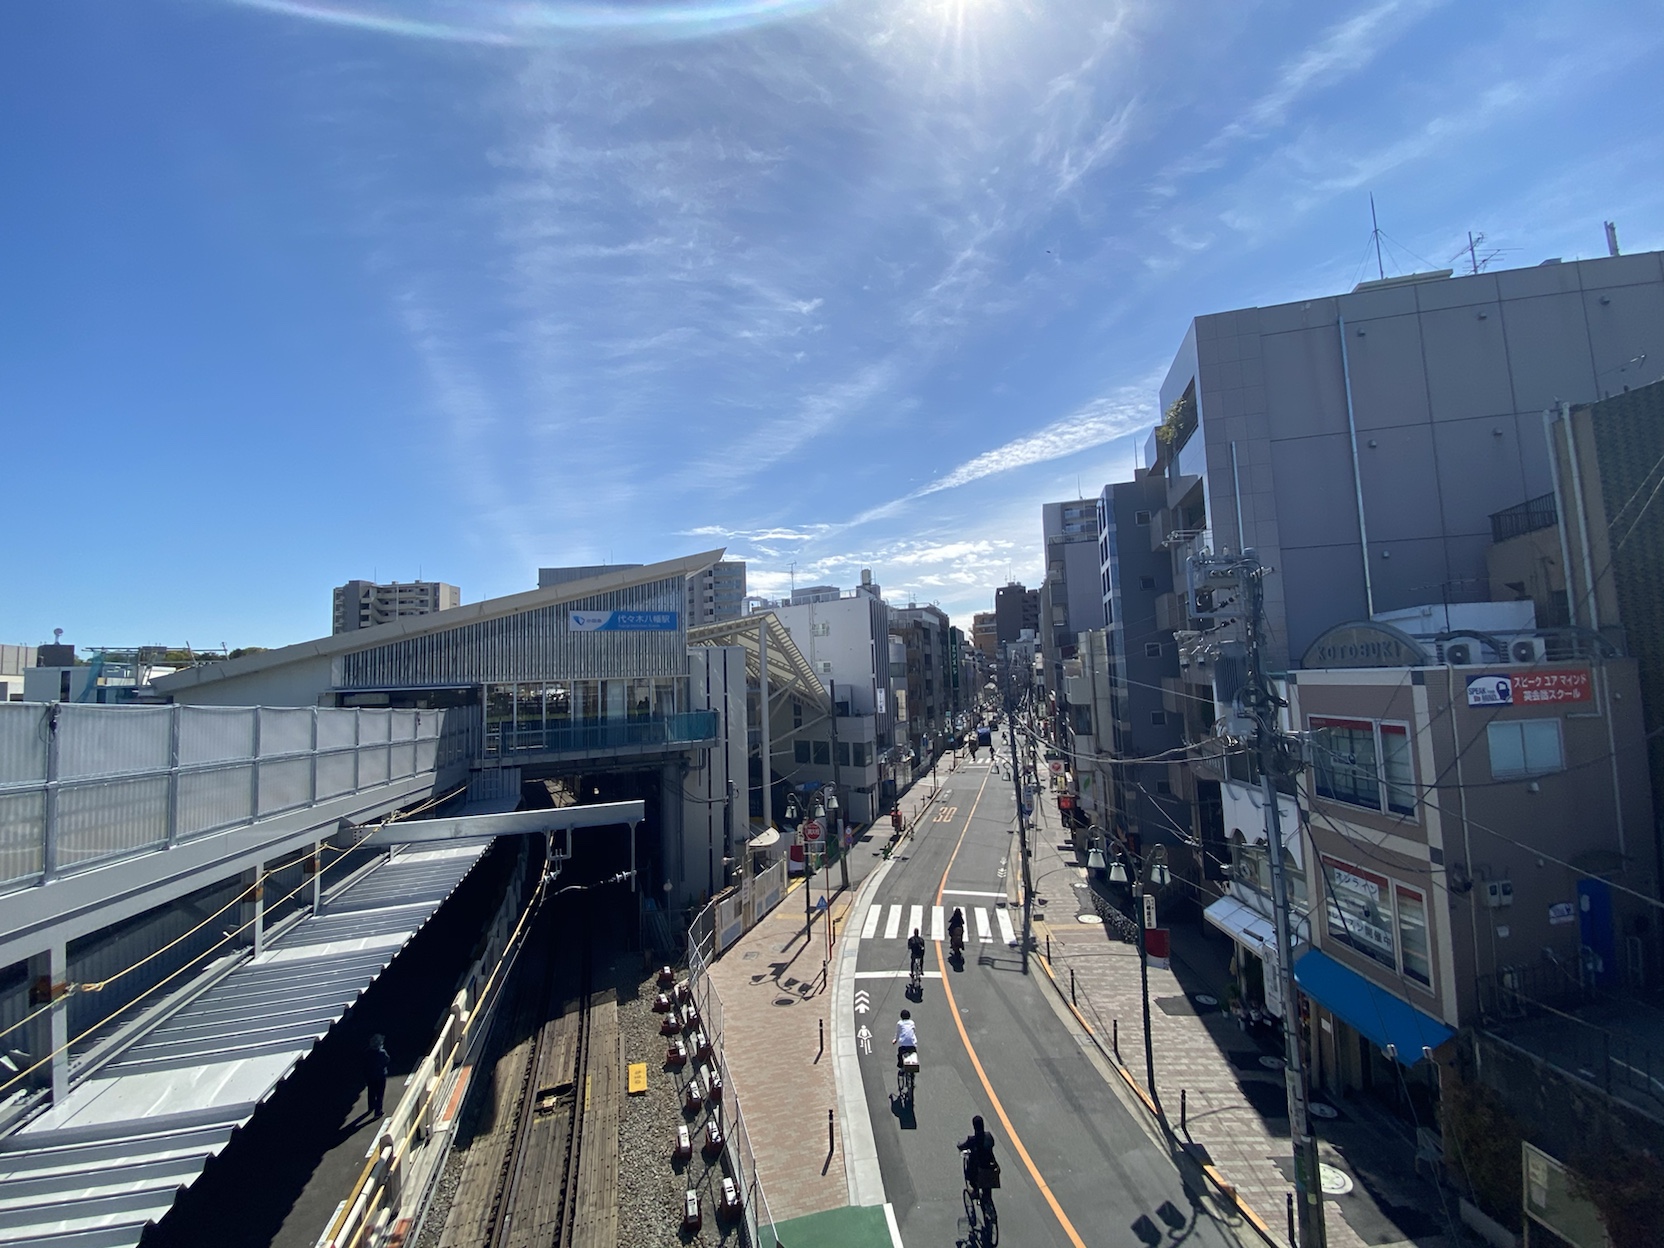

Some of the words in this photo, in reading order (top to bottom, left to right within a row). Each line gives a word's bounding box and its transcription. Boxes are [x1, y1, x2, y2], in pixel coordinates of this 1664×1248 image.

[617, 614, 671, 623] 代々木八幡駅
[1317, 640, 1400, 661] KOTOBUKI
[1514, 676, 1542, 688] スピーク
[1544, 675, 1558, 686] ユア
[1560, 673, 1587, 686] マインド
[1468, 687, 1487, 696] SPEAK
[1523, 688, 1581, 702] 英会話スクール
[932, 806, 958, 823] 30
[1335, 871, 1378, 895] オンライン
